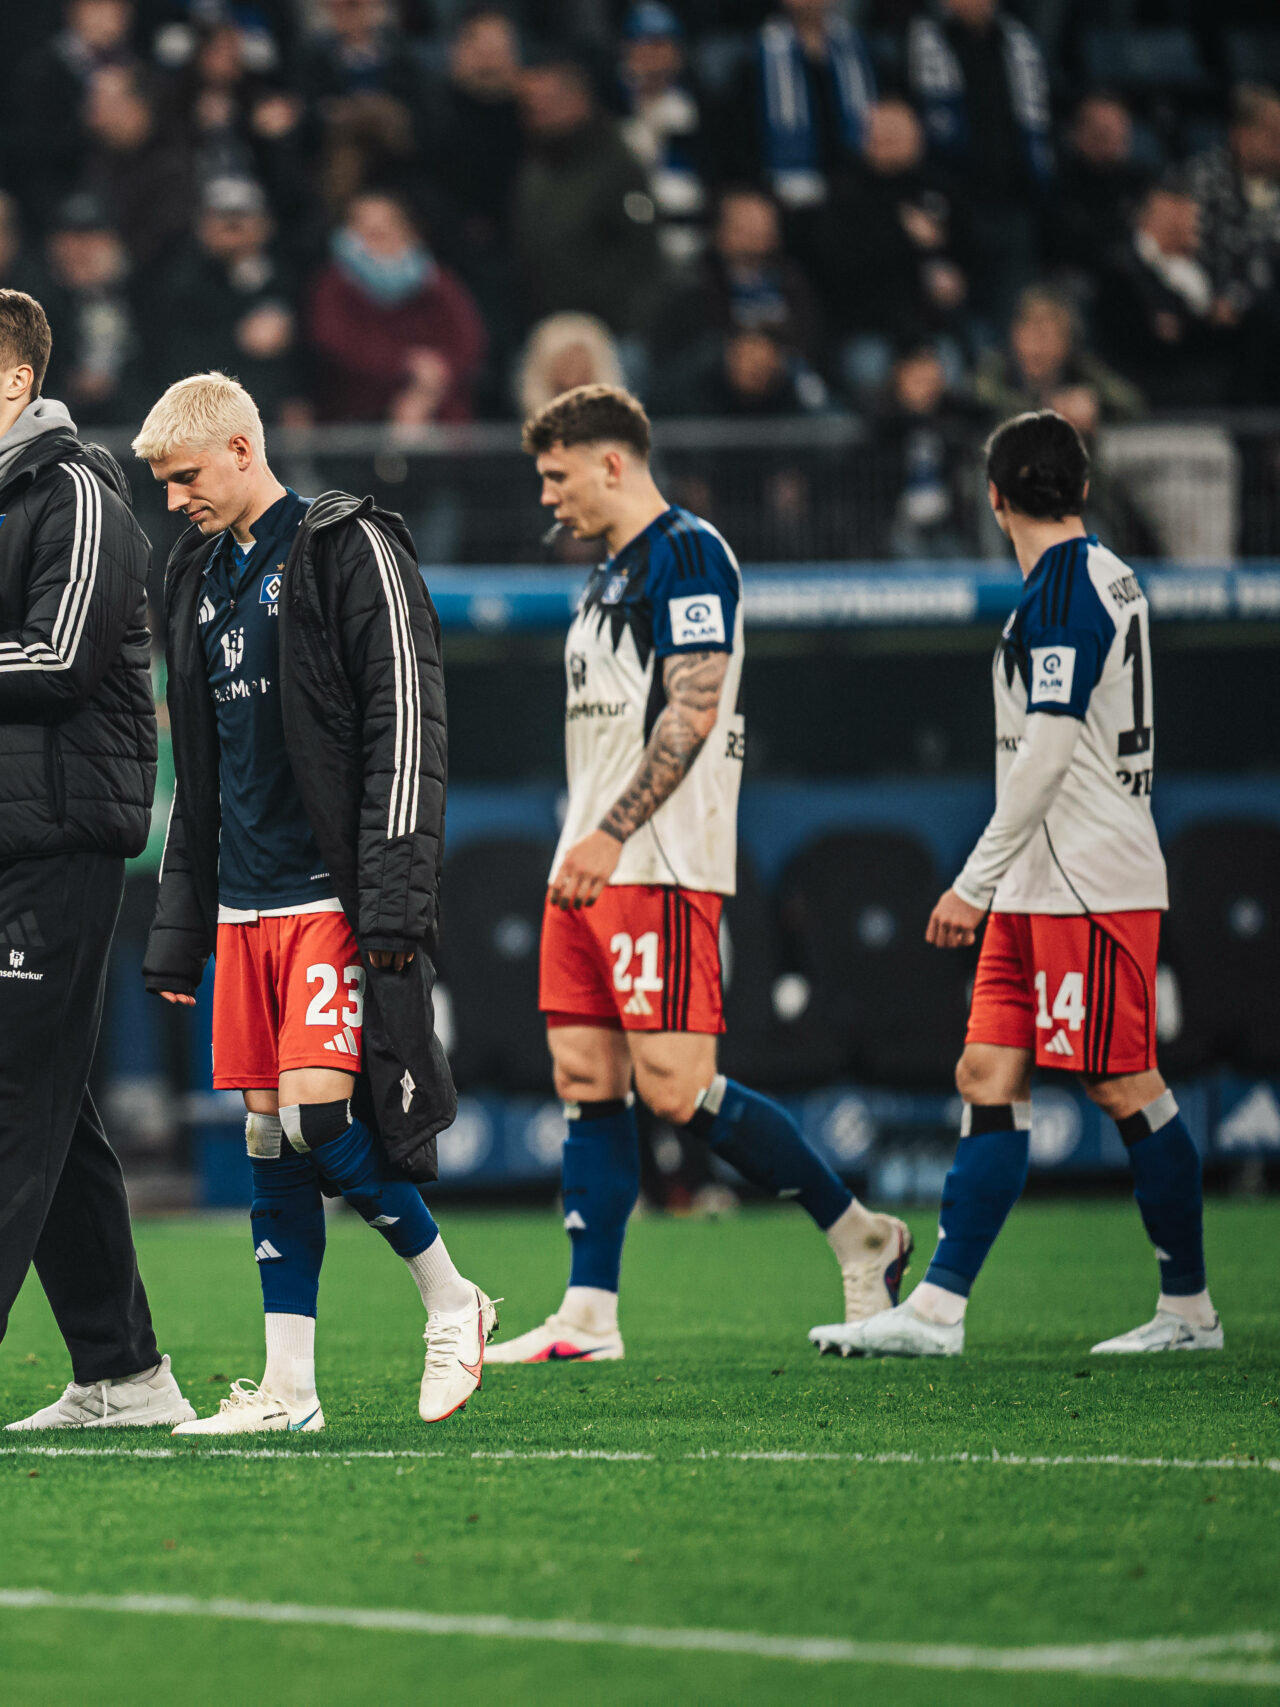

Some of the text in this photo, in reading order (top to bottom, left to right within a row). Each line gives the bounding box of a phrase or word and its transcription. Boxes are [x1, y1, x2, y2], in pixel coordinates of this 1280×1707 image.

[267, 603, 279, 616] 14
[610, 931, 664, 992] 21
[305, 963, 367, 1028] 23
[1034, 970, 1086, 1031] 14
